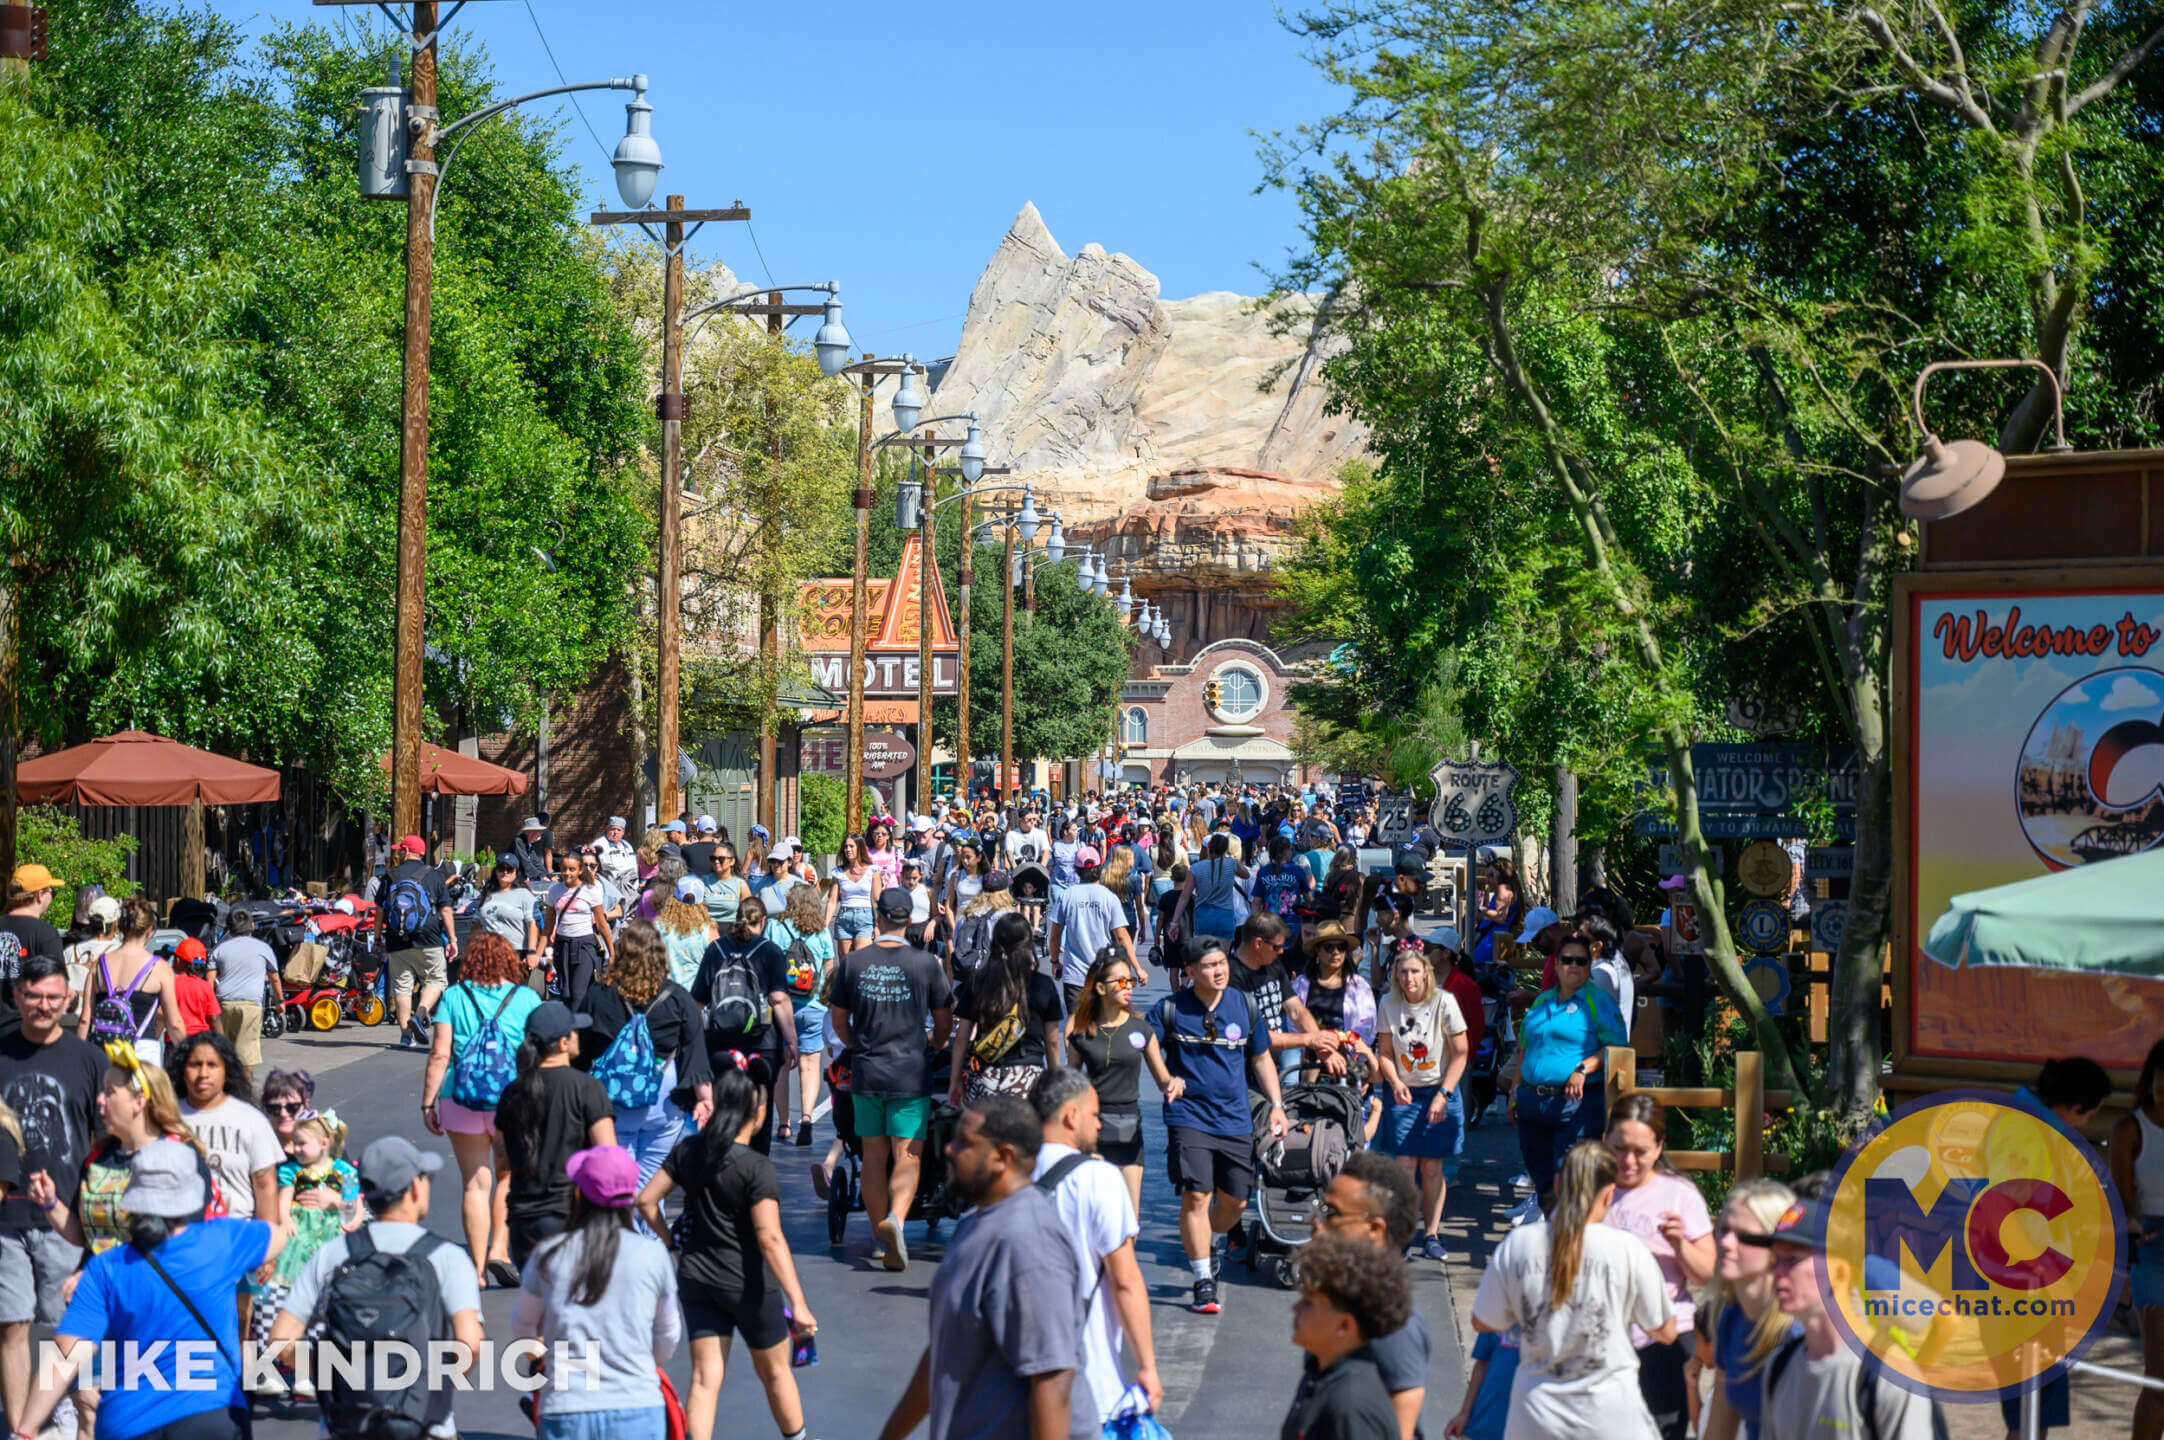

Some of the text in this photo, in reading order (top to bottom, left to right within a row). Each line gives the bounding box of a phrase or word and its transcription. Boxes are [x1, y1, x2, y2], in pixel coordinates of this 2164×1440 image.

[802, 613, 885, 637] COE
[1934, 606, 2160, 663] Welcome to
[811, 656, 954, 688] MOTEL
[863, 751, 908, 760] RIGERATED
[1715, 752, 1783, 764] WELCOME
[1450, 773, 1501, 788] ROUTE
[1766, 767, 1858, 807] SPRNG
[1384, 810, 1408, 831] 25
[1444, 792, 1505, 833] 66
[1648, 821, 1712, 833] GATY
